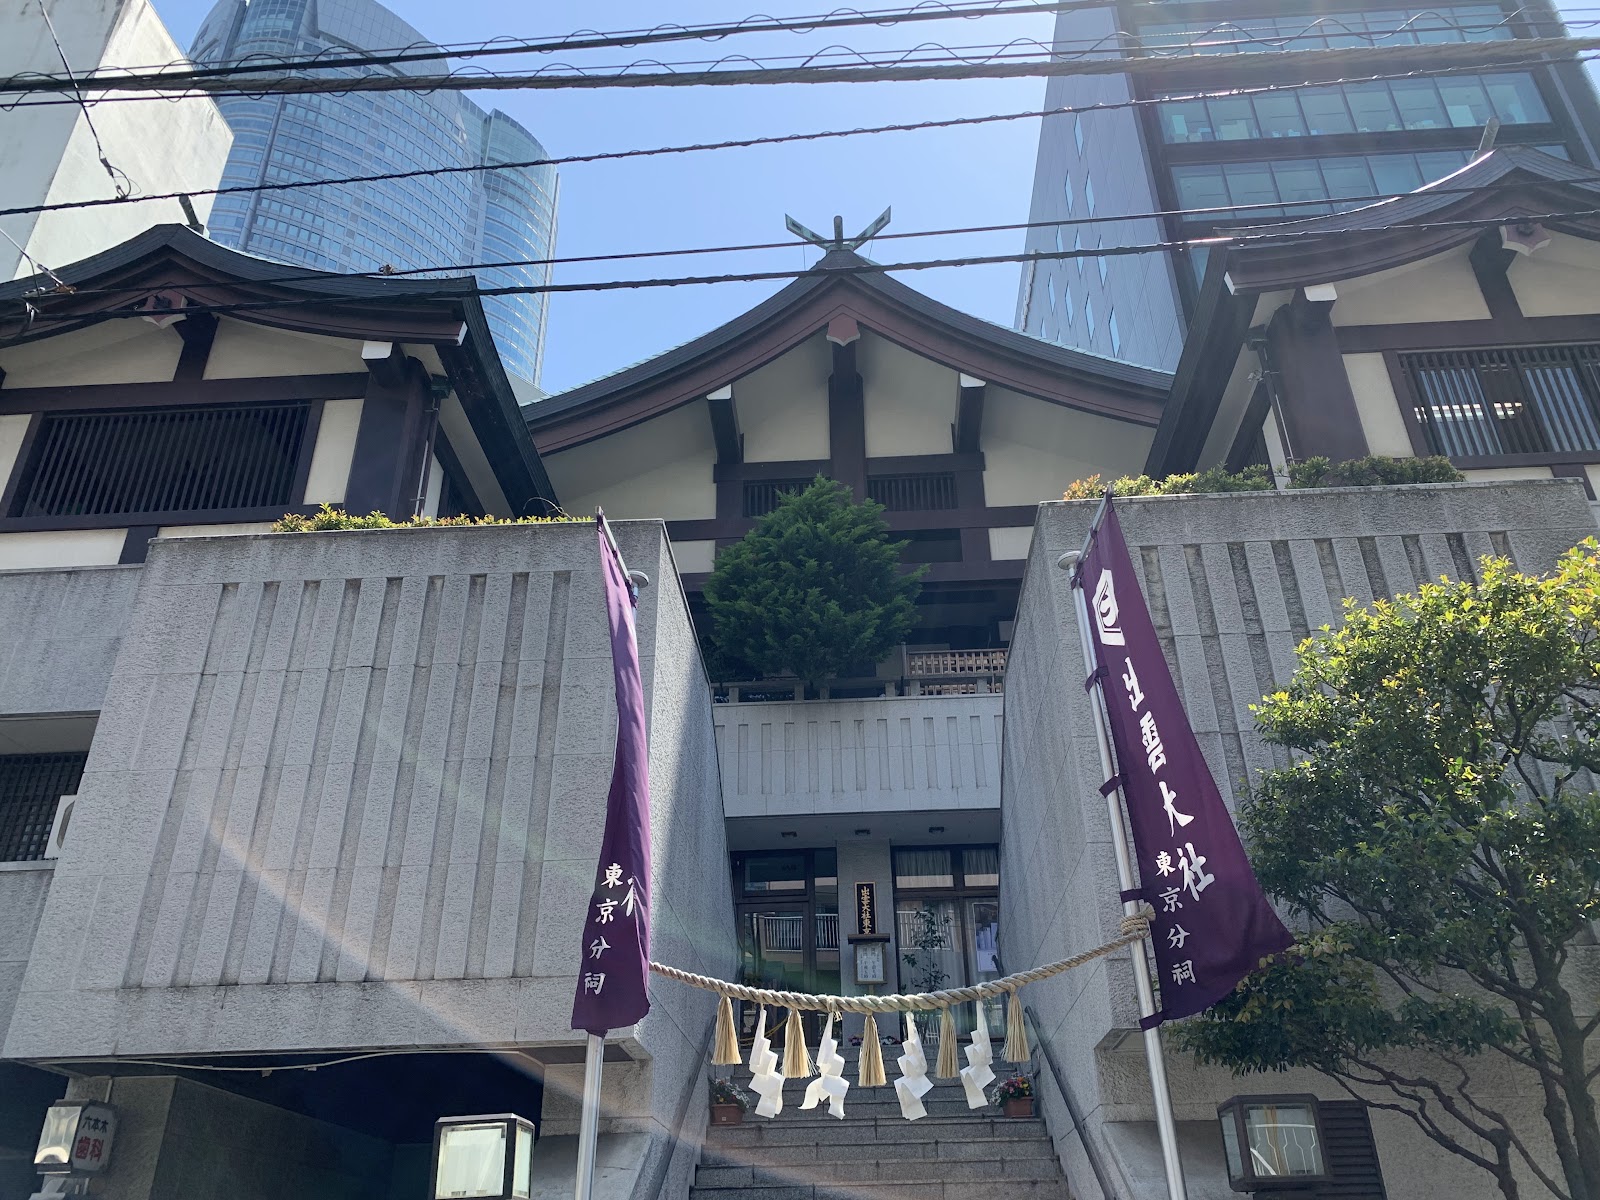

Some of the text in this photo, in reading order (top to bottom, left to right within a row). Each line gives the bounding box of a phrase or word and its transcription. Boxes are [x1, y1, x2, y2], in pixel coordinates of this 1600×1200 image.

[584, 862, 624, 996] 東京分祠
[1154, 850, 1197, 986] 東京分祠
[76, 1136, 104, 1162] 歯科
[82, 1116, 109, 1133] 六本木
